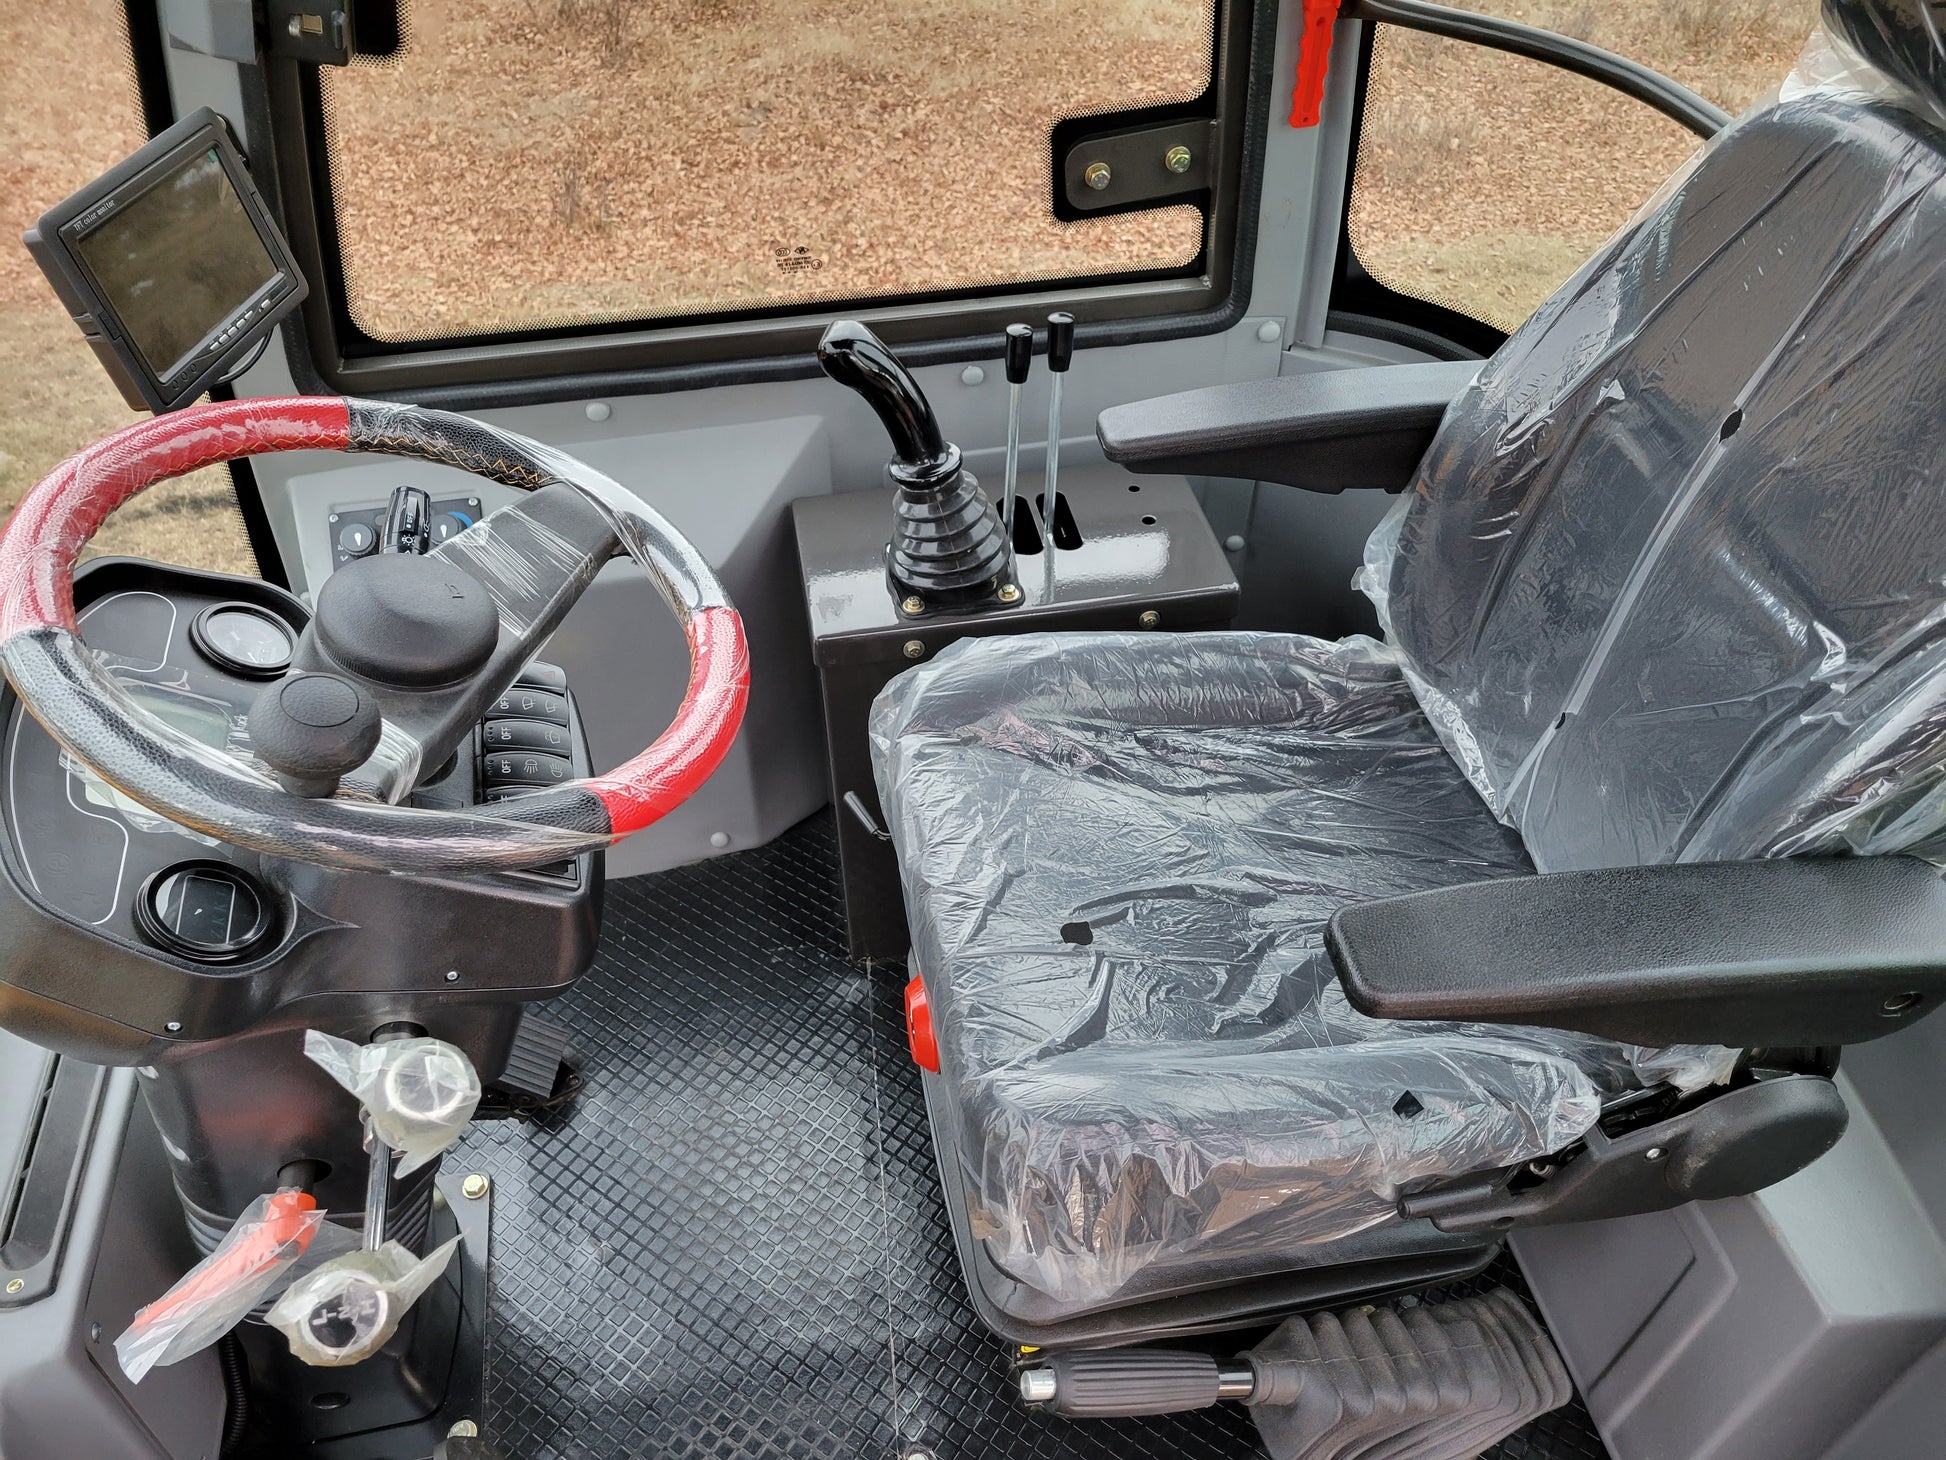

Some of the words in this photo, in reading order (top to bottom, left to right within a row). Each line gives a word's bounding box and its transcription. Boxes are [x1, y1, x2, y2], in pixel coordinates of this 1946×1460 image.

[73, 220, 84, 231] TFT
[83, 212, 97, 225] color
[96, 200, 115, 216] monitor
[500, 696, 510, 709] OFF
[501, 726, 512, 740] OFF
[501, 759, 512, 774] OFF
